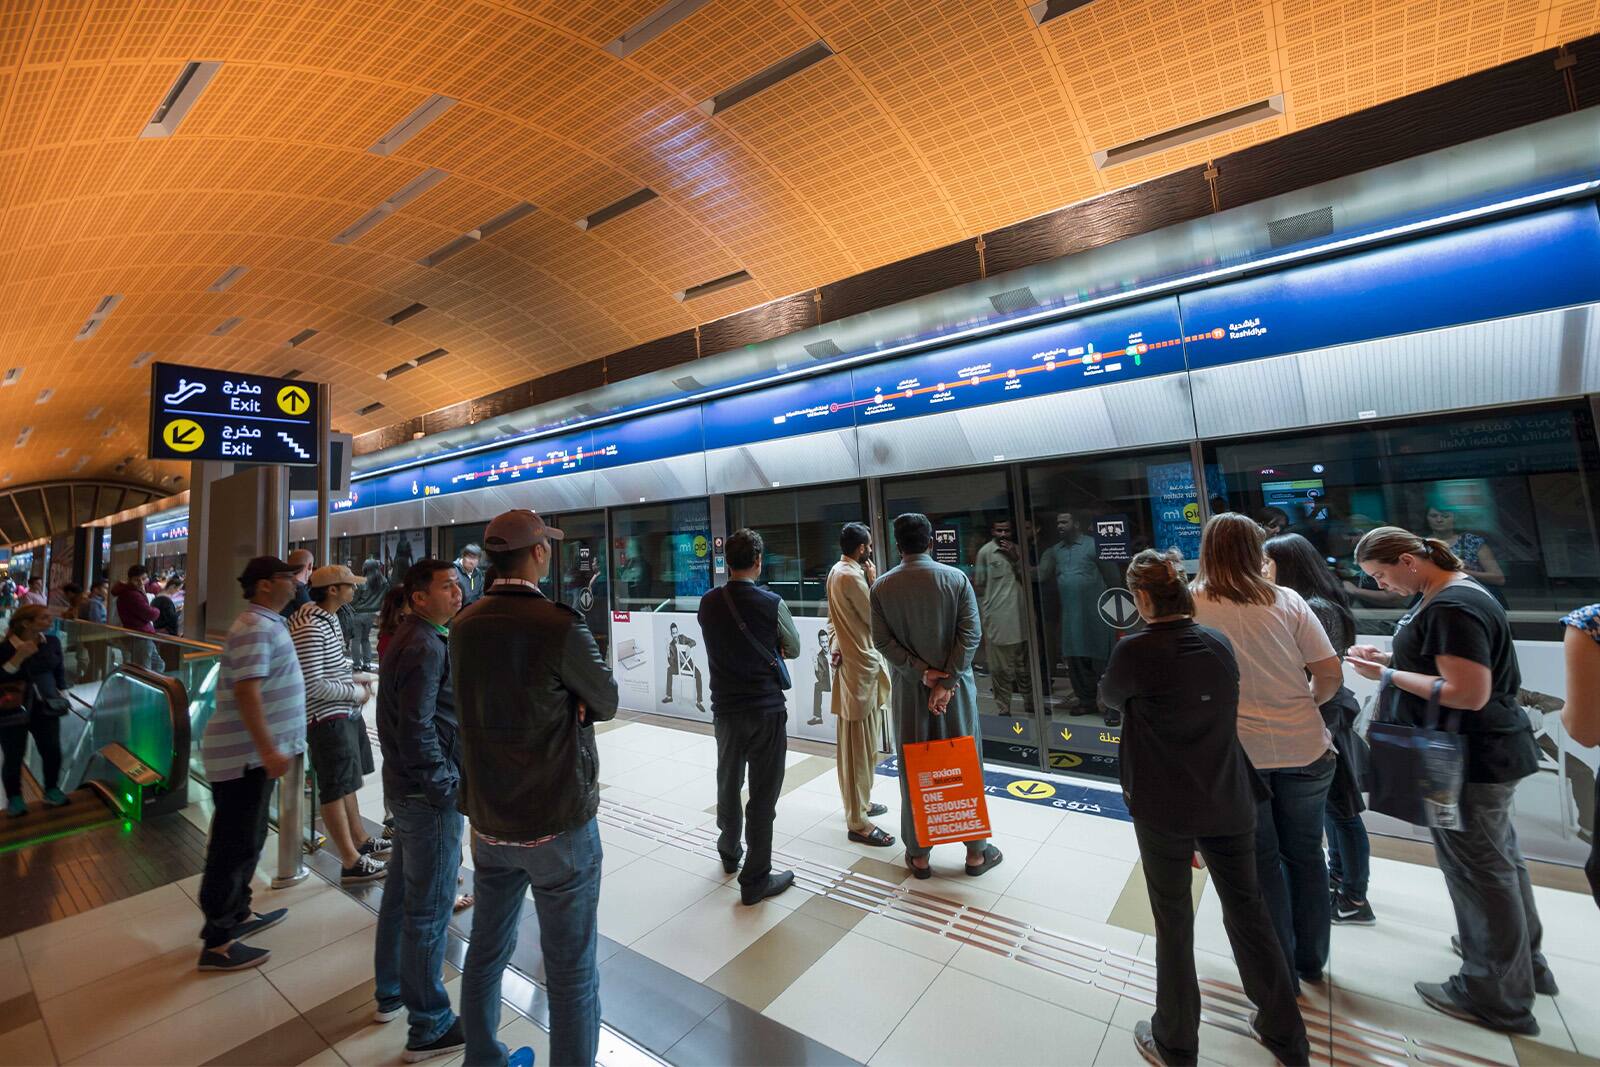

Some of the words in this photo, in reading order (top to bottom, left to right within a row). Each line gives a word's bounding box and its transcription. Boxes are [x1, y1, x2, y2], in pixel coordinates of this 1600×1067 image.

[222, 380, 262, 395] مخرج
[230, 397, 261, 412] Exit
[221, 425, 261, 438] مخرج
[221, 441, 253, 456] Exit
[932, 767, 961, 779] axiom
[922, 791, 944, 804] ONE
[1052, 796, 1101, 814] خروج
[924, 797, 979, 815] SERIOUSLY
[926, 811, 978, 826] AWESOME
[927, 820, 986, 836] PURCHASE.
